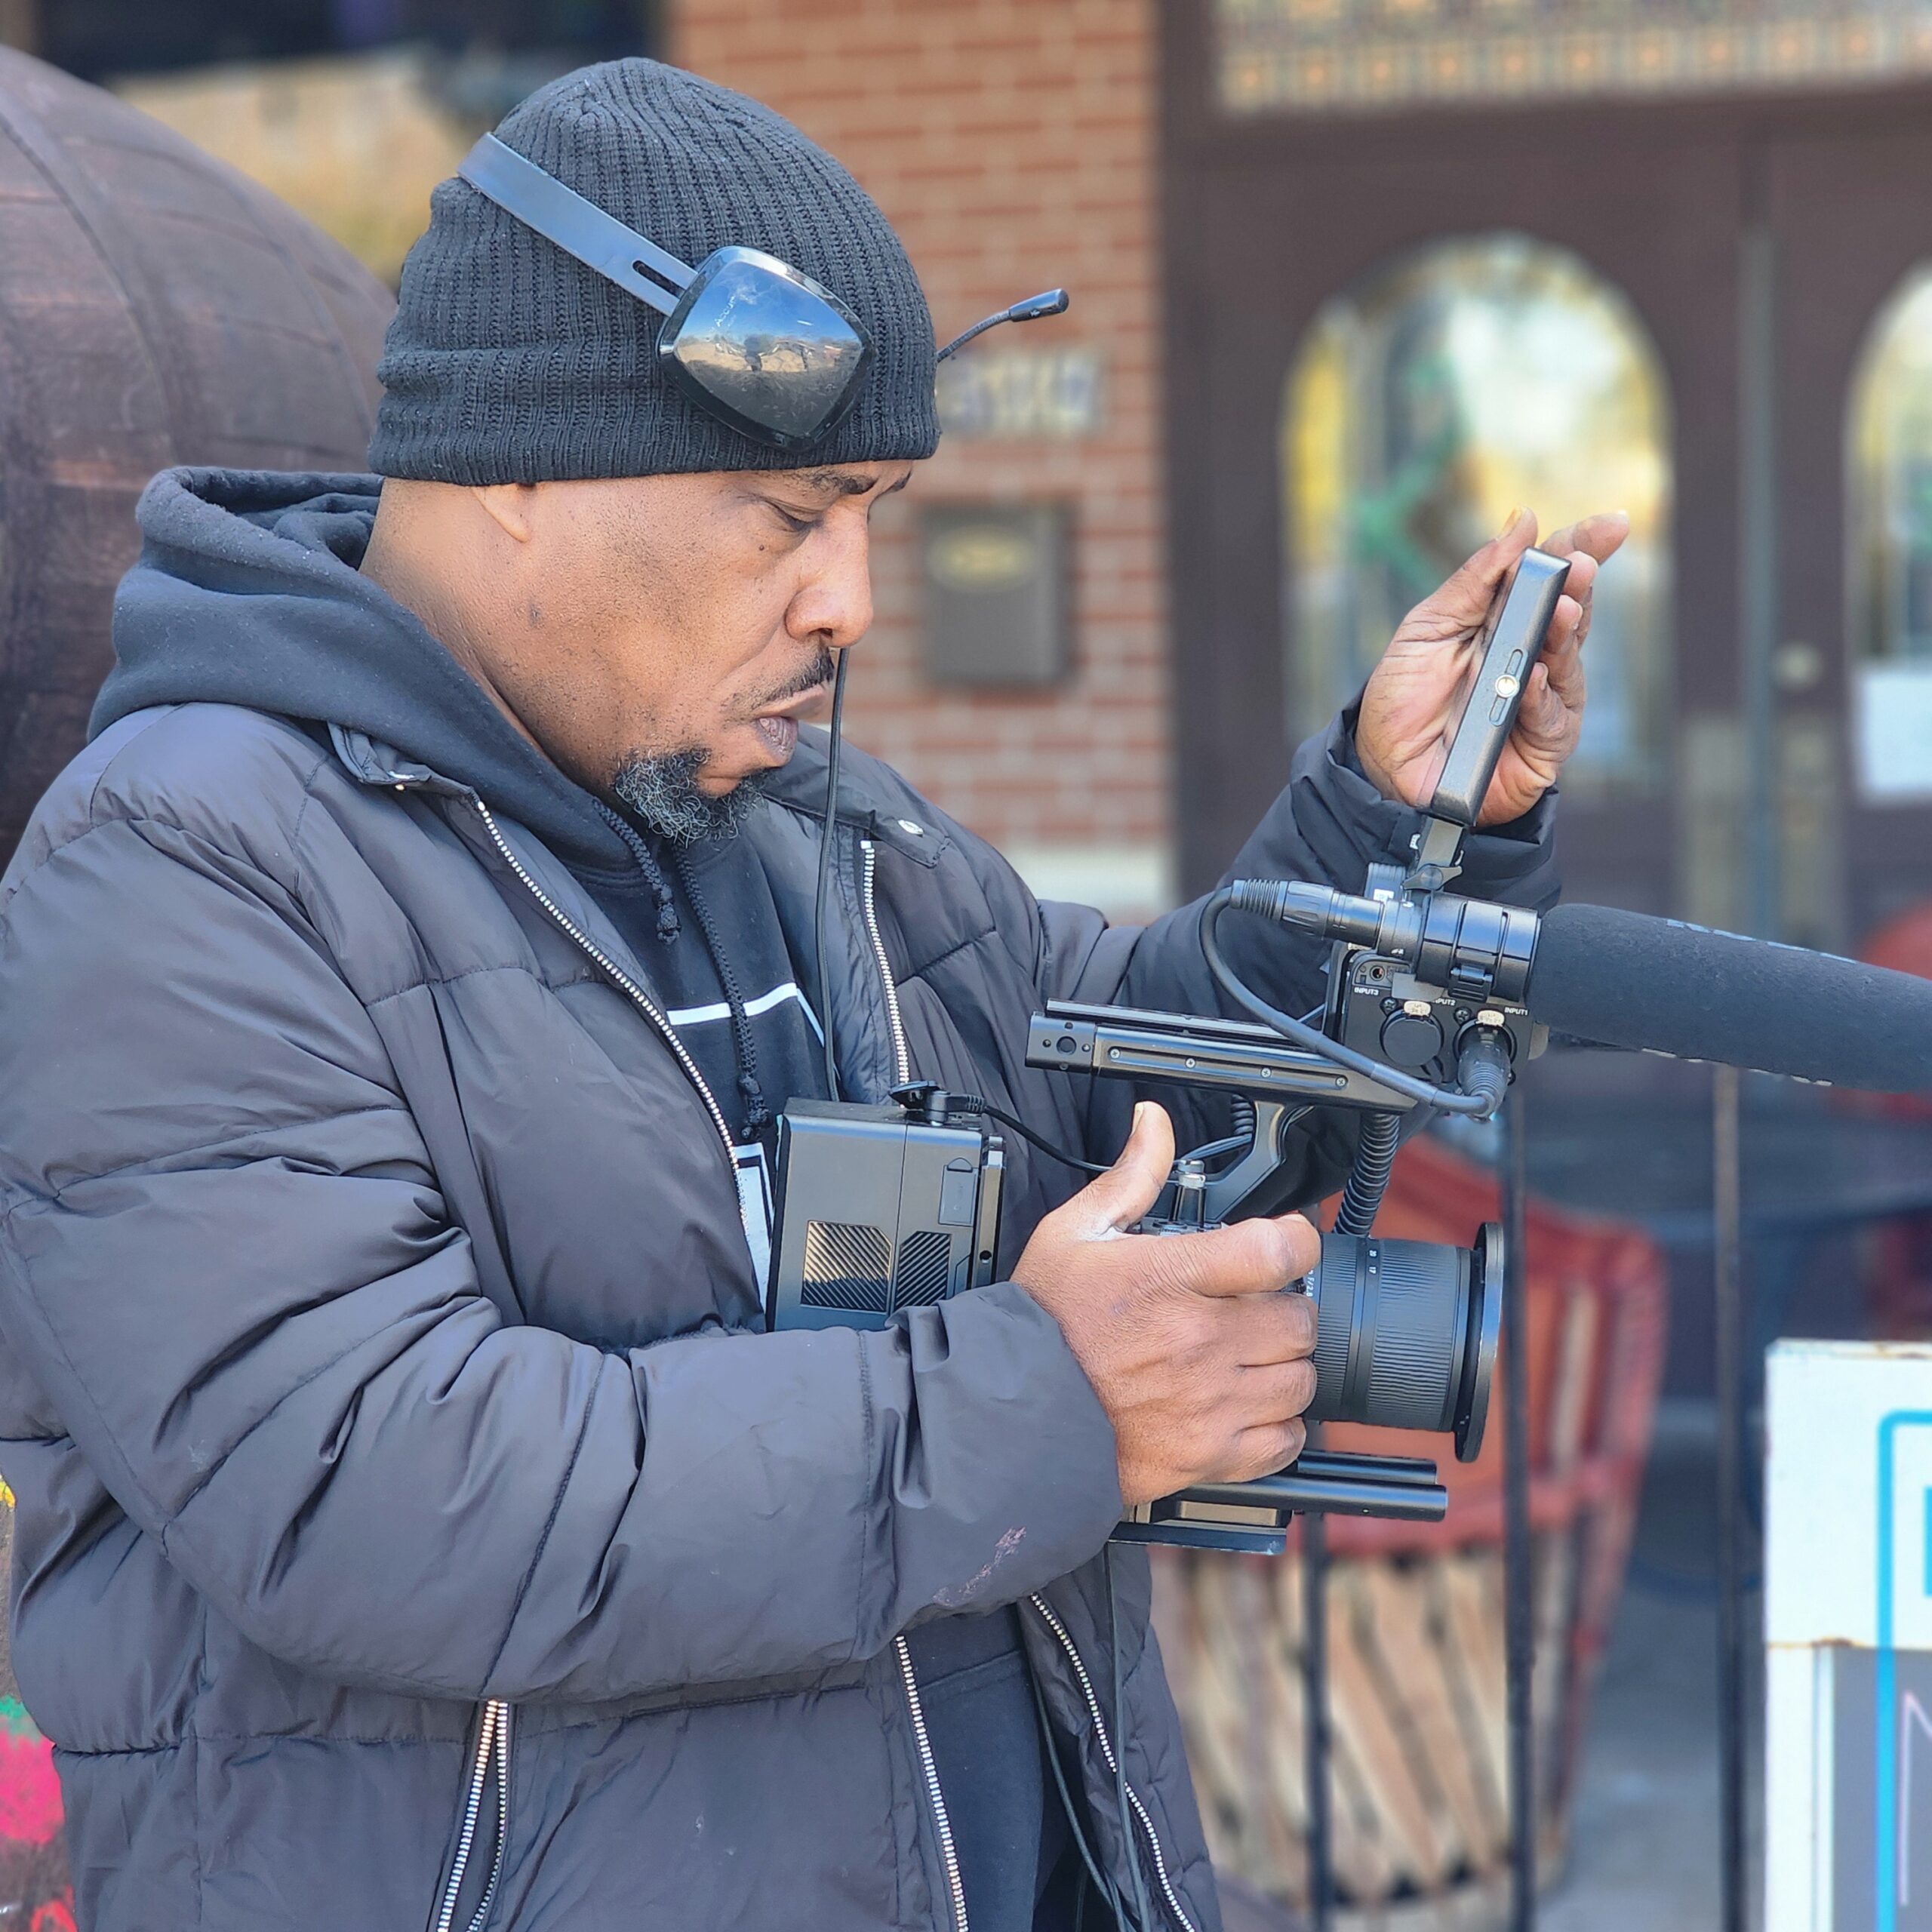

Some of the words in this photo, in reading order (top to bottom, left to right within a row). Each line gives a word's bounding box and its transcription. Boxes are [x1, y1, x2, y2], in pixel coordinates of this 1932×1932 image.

[1355, 987, 1379, 995] INPUT3
[1434, 998, 1456, 1006] NPUT2
[1505, 1006, 1528, 1016] INPUT1
